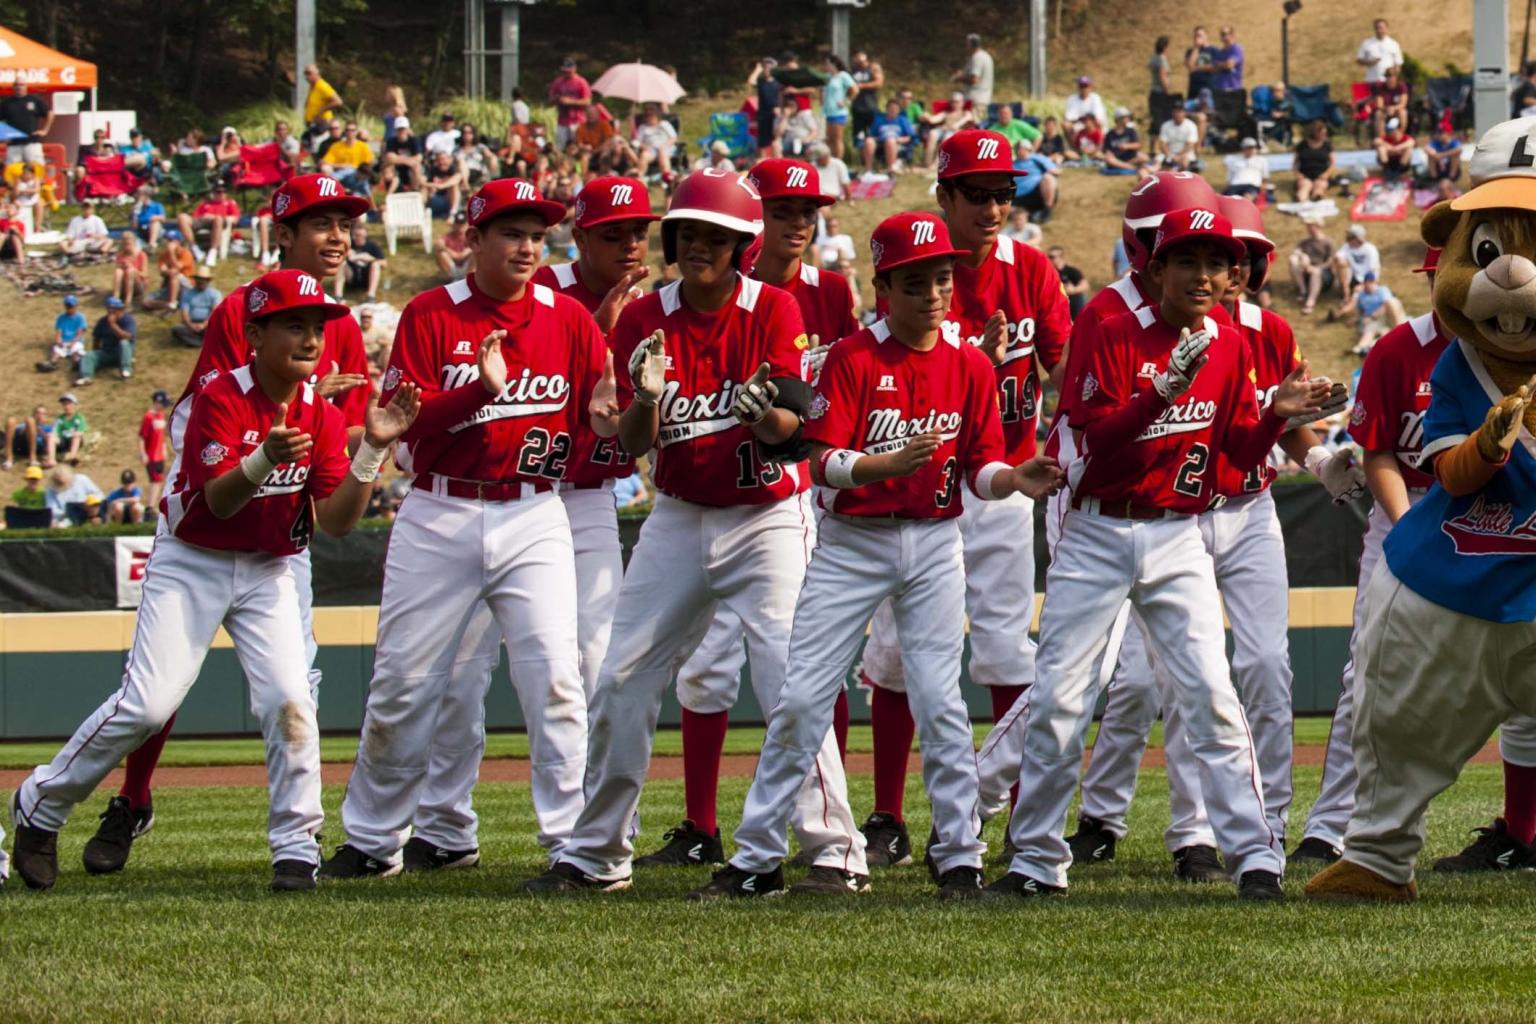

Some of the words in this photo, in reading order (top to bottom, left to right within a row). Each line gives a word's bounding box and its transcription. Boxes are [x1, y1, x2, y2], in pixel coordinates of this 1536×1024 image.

[867, 407, 963, 443] Mexico
[515, 426, 572, 480] 22
[1172, 441, 1210, 498] 2
[934, 455, 957, 509] 3
